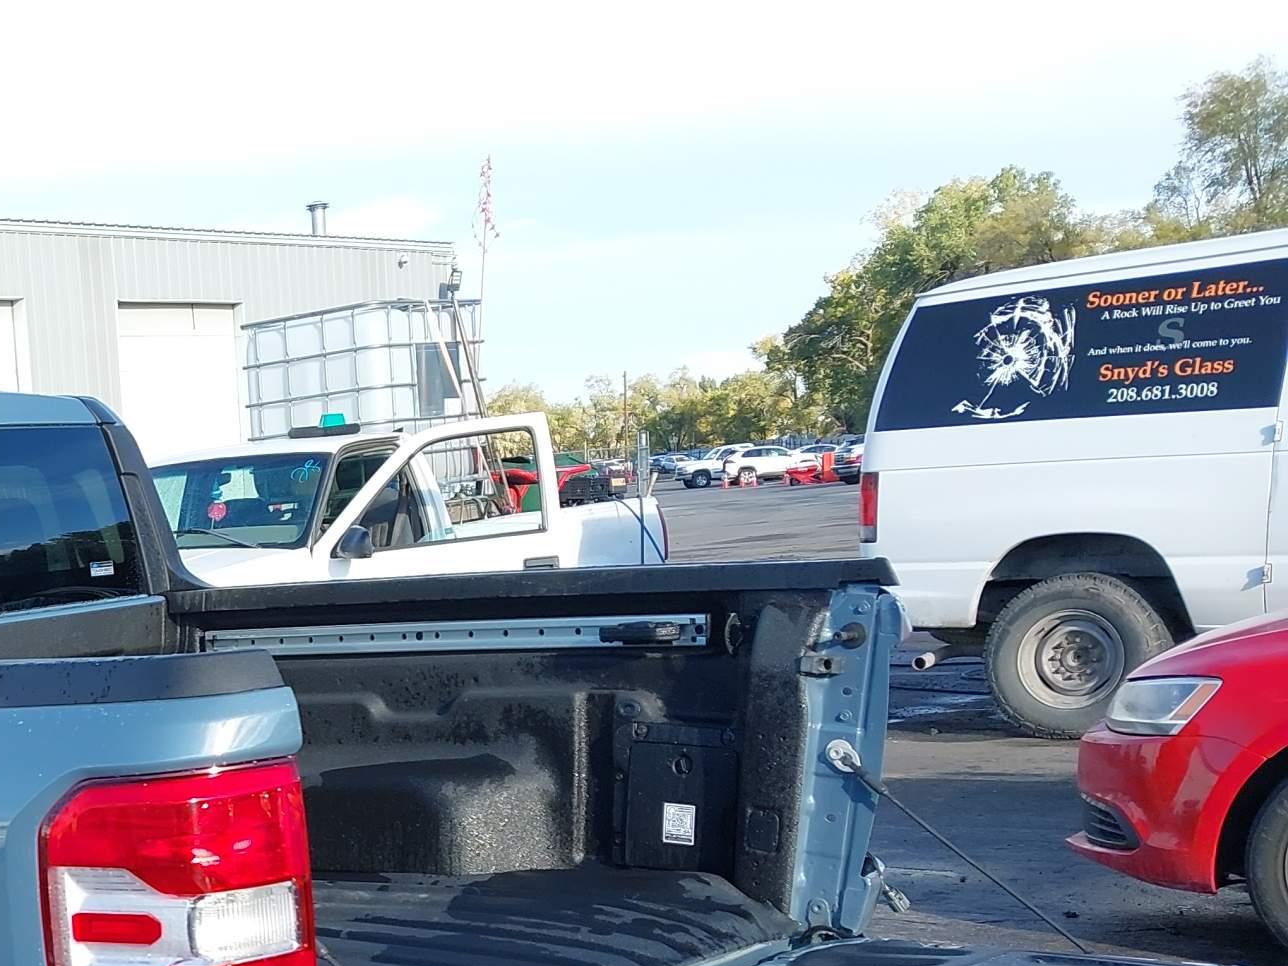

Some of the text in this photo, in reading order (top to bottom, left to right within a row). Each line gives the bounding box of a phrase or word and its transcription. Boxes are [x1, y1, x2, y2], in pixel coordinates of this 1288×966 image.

[1086, 279, 1264, 309] Sooner or Later...
[1100, 294, 1281, 320] A Rock Will Rise Up to Greet You
[1158, 317, 1185, 346] S
[1087, 347, 1107, 356] And
[1109, 345, 1133, 354] when
[1135, 343, 1142, 352] it
[1168, 340, 1191, 350] we'll
[1192, 340, 1217, 348] come
[1219, 338, 1229, 346] to
[1230, 337, 1253, 347] you.
[1099, 357, 1234, 385] Snyd's Glass
[1106, 382, 1218, 403] 208.681.3008
